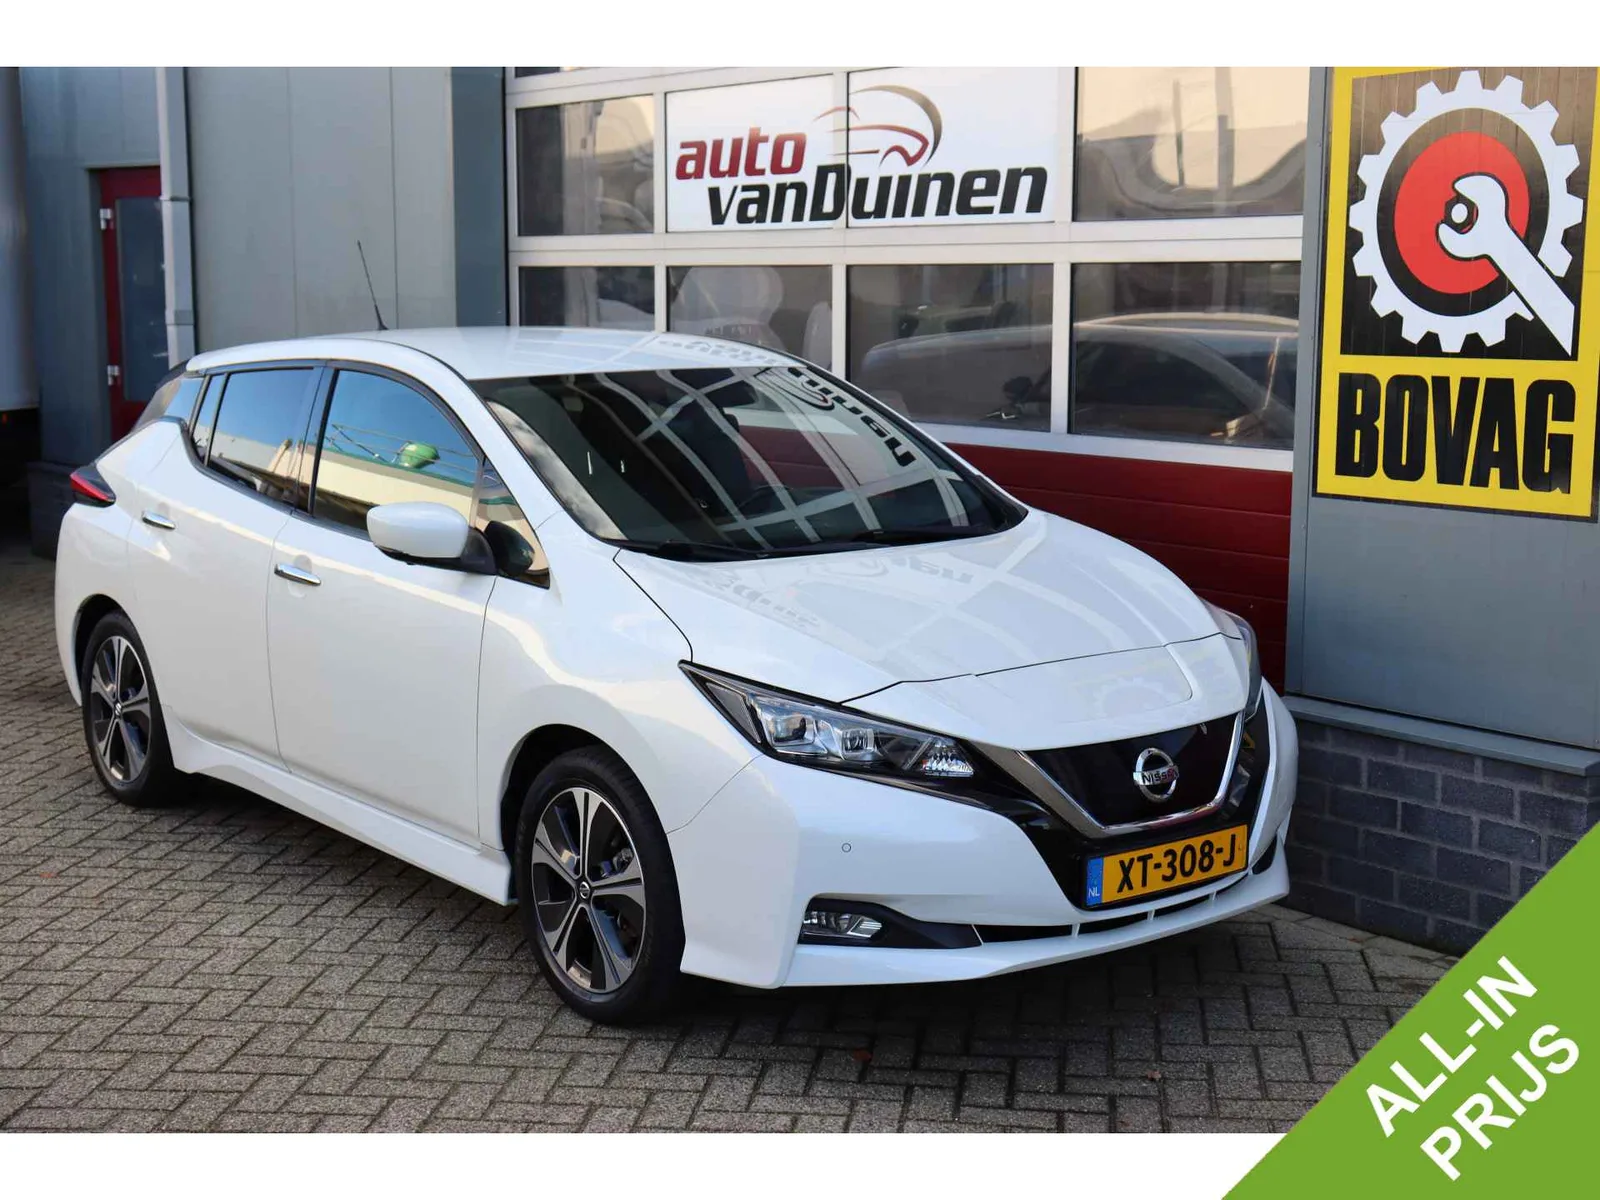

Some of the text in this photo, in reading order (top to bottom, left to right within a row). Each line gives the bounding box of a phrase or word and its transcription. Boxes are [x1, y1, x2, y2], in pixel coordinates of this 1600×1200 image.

[676, 127, 806, 180] auto
[1335, 372, 1576, 494] BOVAG
[1117, 834, 1236, 893] XT-308-J
[1088, 886, 1101, 898] NL
